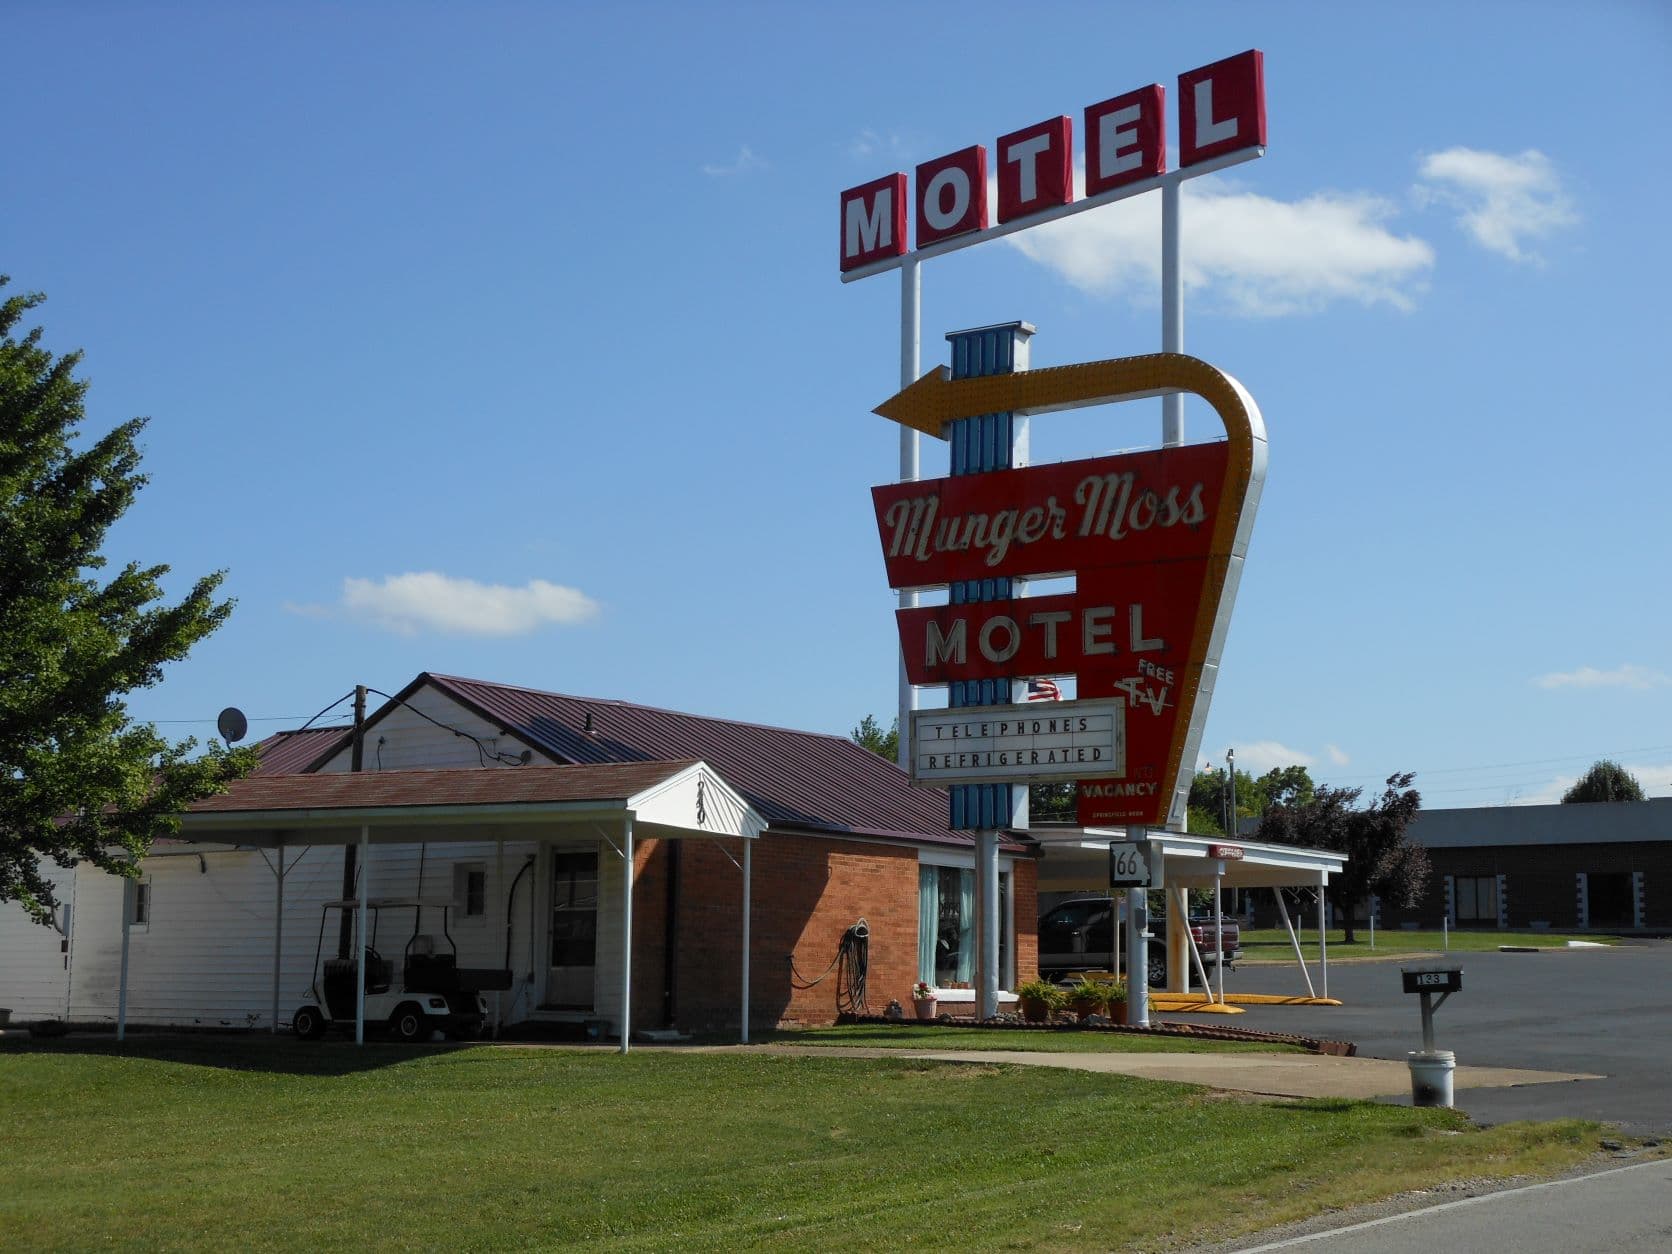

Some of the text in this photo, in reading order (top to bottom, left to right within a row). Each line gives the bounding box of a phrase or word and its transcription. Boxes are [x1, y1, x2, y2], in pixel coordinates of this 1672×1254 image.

[846, 78, 1238, 258] MOTEL
[884, 471, 1207, 567] Munger Moss
[925, 603, 1165, 667] MOTEL
[1138, 658, 1175, 686] FREE
[1114, 677, 1171, 716] TV
[935, 717, 1088, 739] TELEPHONES
[929, 748, 1102, 769] REFRIGERATED
[1082, 782, 1158, 798] VACANCY
[1117, 851, 1137, 875] 66
